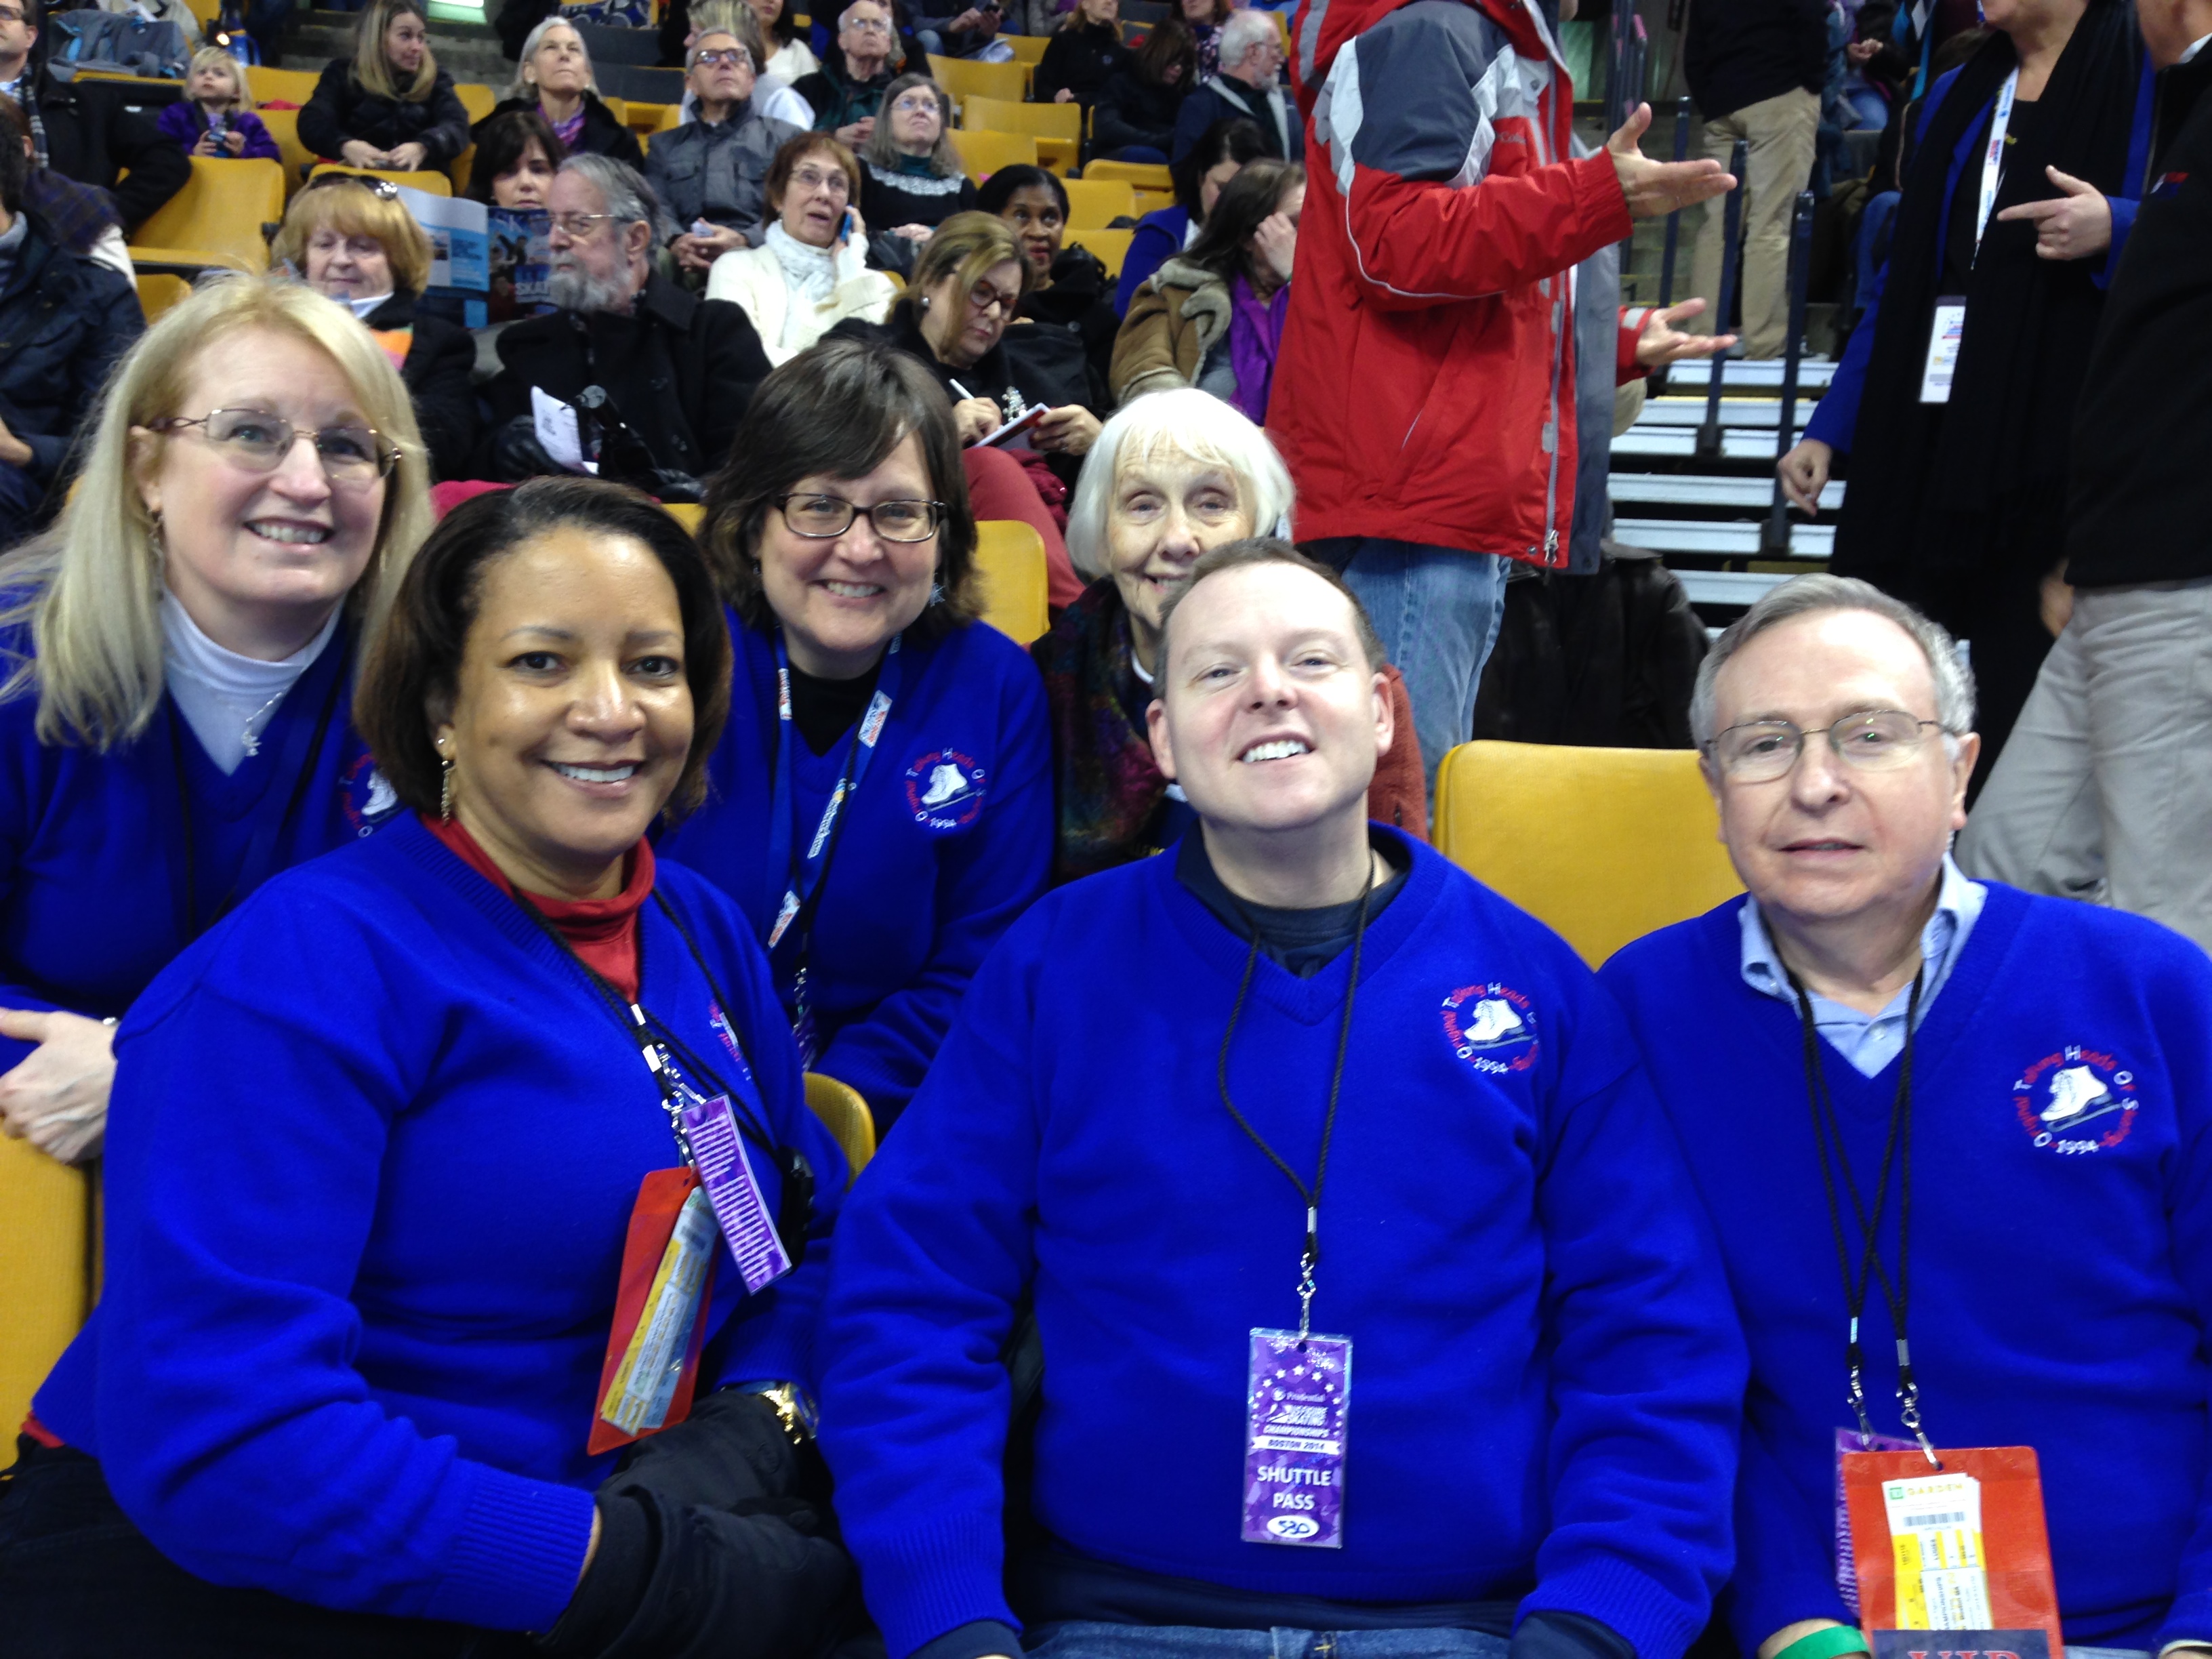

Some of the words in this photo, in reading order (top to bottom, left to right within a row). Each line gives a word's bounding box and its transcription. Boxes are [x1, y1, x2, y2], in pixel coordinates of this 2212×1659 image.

[929, 817, 957, 829] 1994
[1473, 1057, 1509, 1075] 1994
[2055, 1139, 2099, 1155] 1994
[1268, 1439, 1301, 1448] BOSTON
[1303, 1441, 1325, 1450] 2014
[1256, 1465, 1332, 1486] SHUTTLE
[1273, 1493, 1315, 1510] PASS
